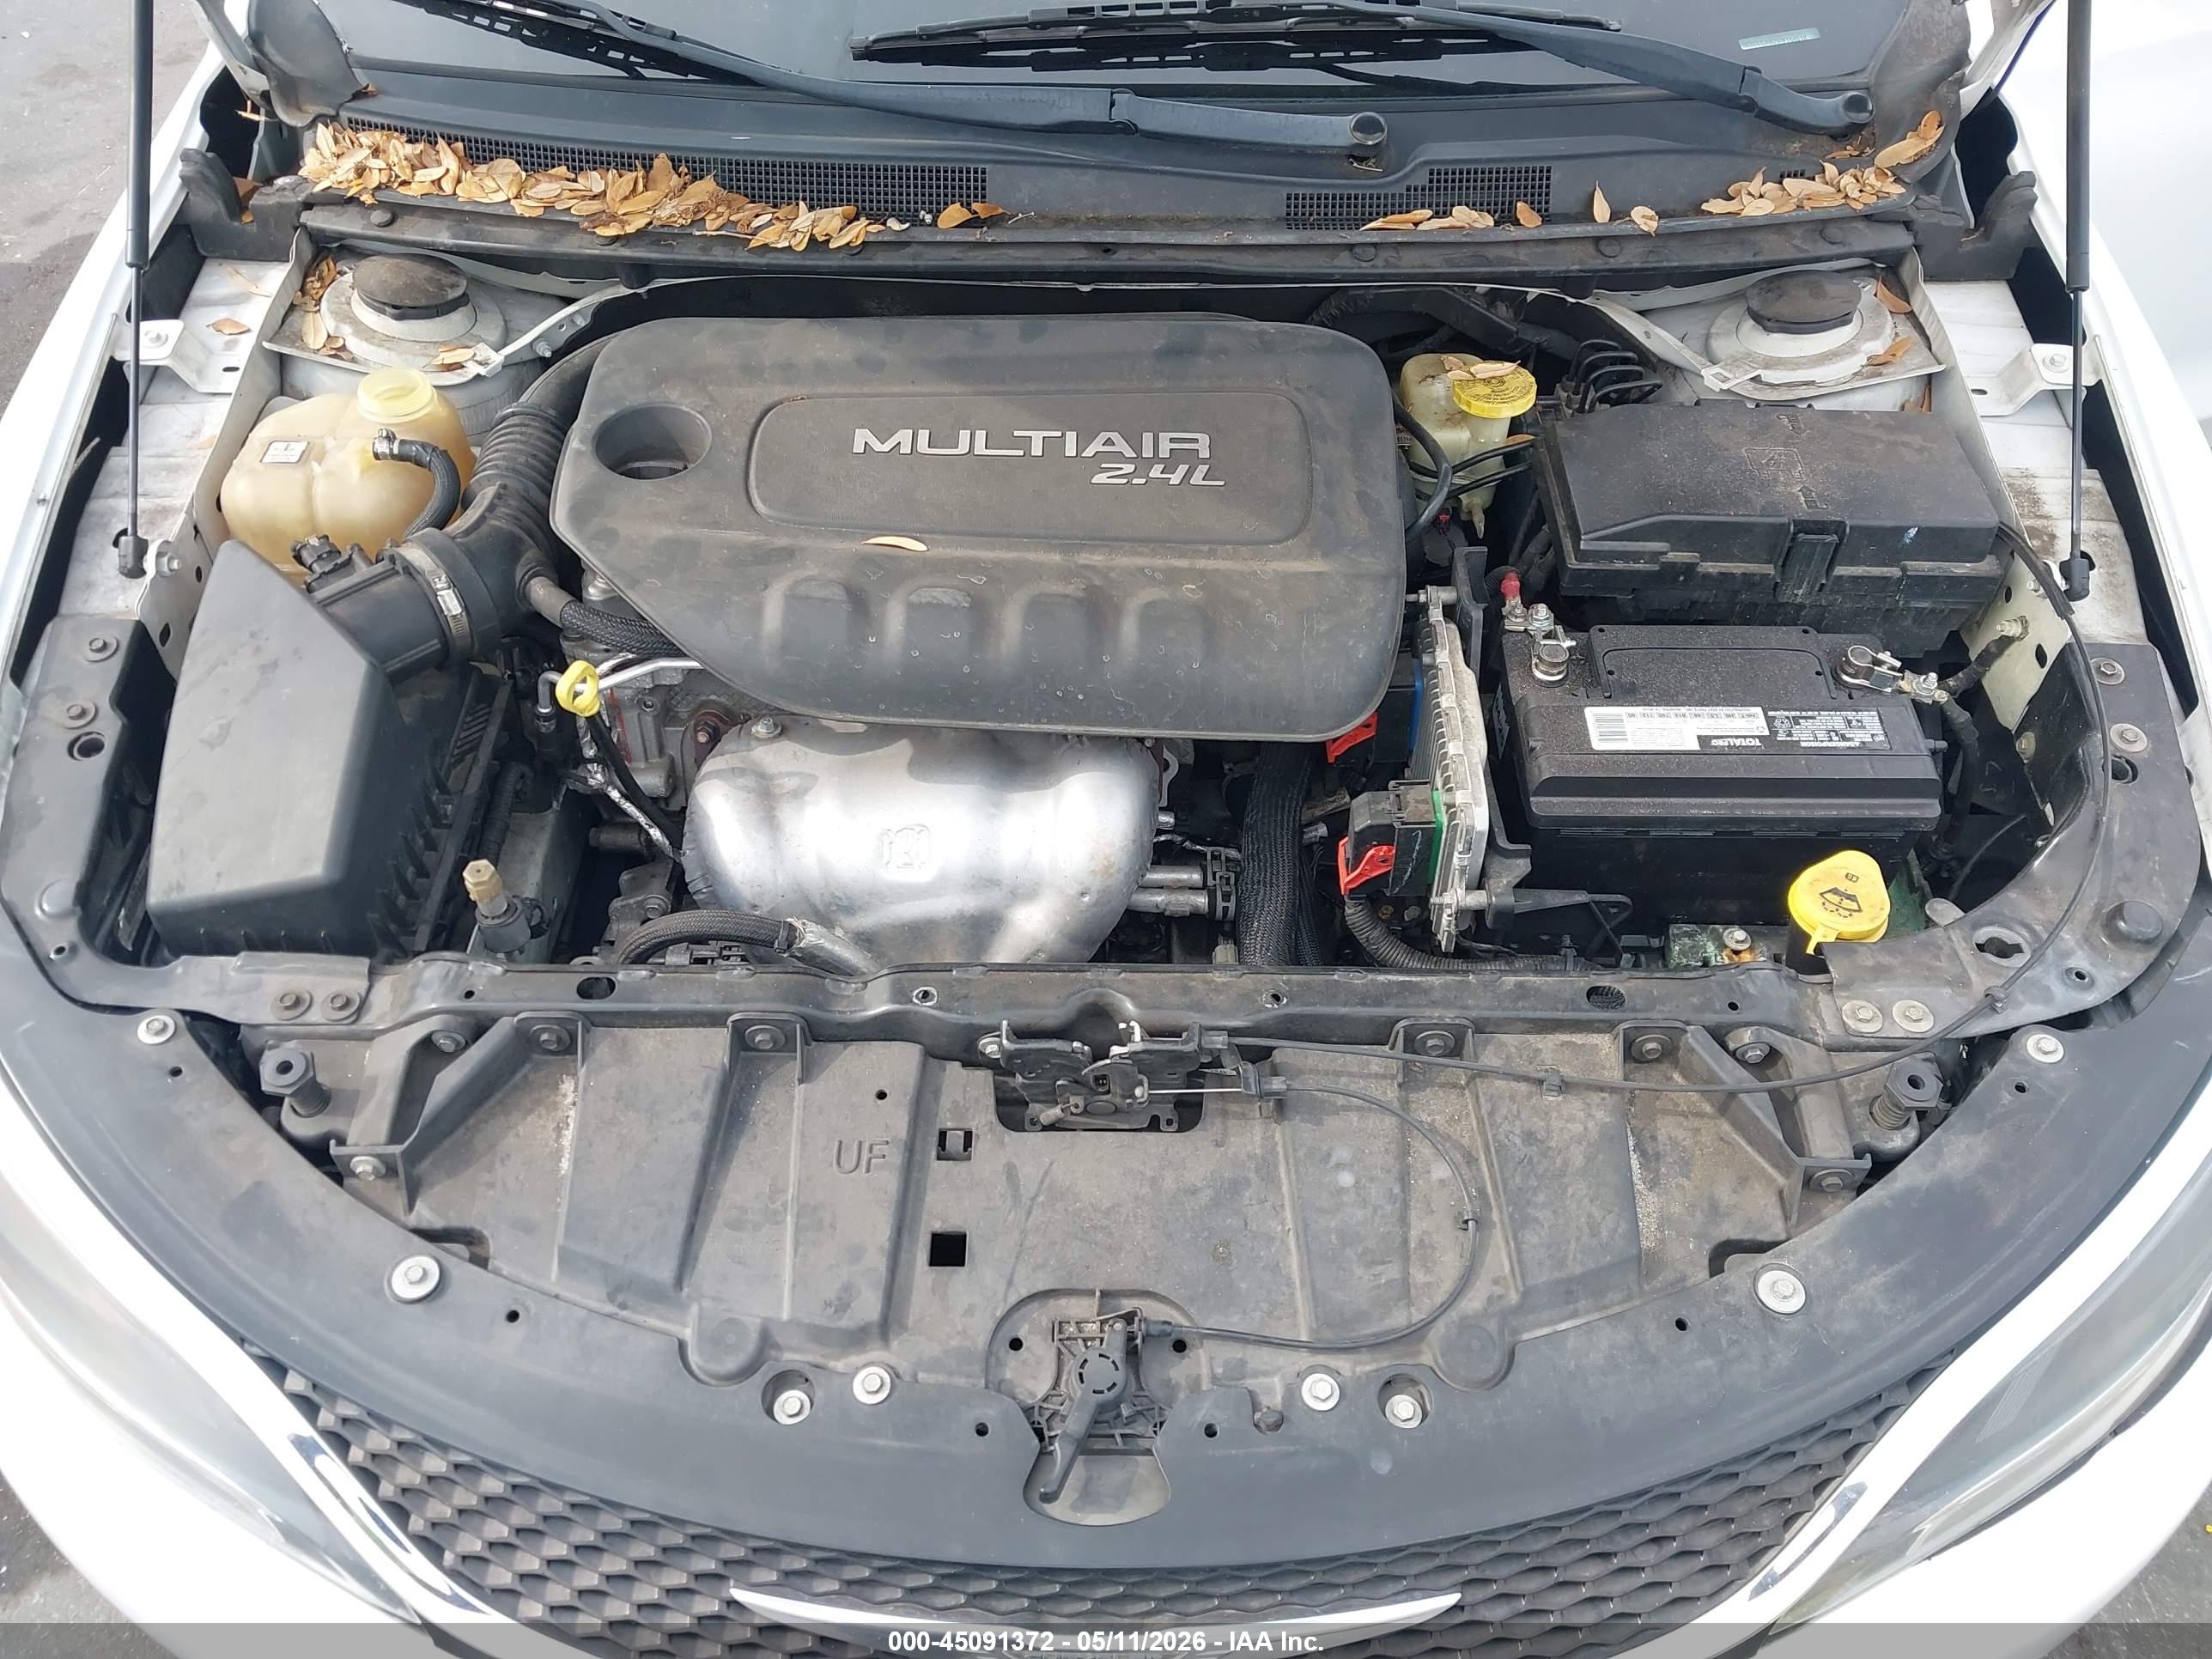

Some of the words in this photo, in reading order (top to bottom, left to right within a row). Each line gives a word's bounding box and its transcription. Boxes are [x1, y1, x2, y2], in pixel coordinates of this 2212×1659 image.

[852, 428, 1211, 459] MULTIAIR
[1090, 462, 1226, 486] 2.4L
[833, 1139, 890, 1175] UF
